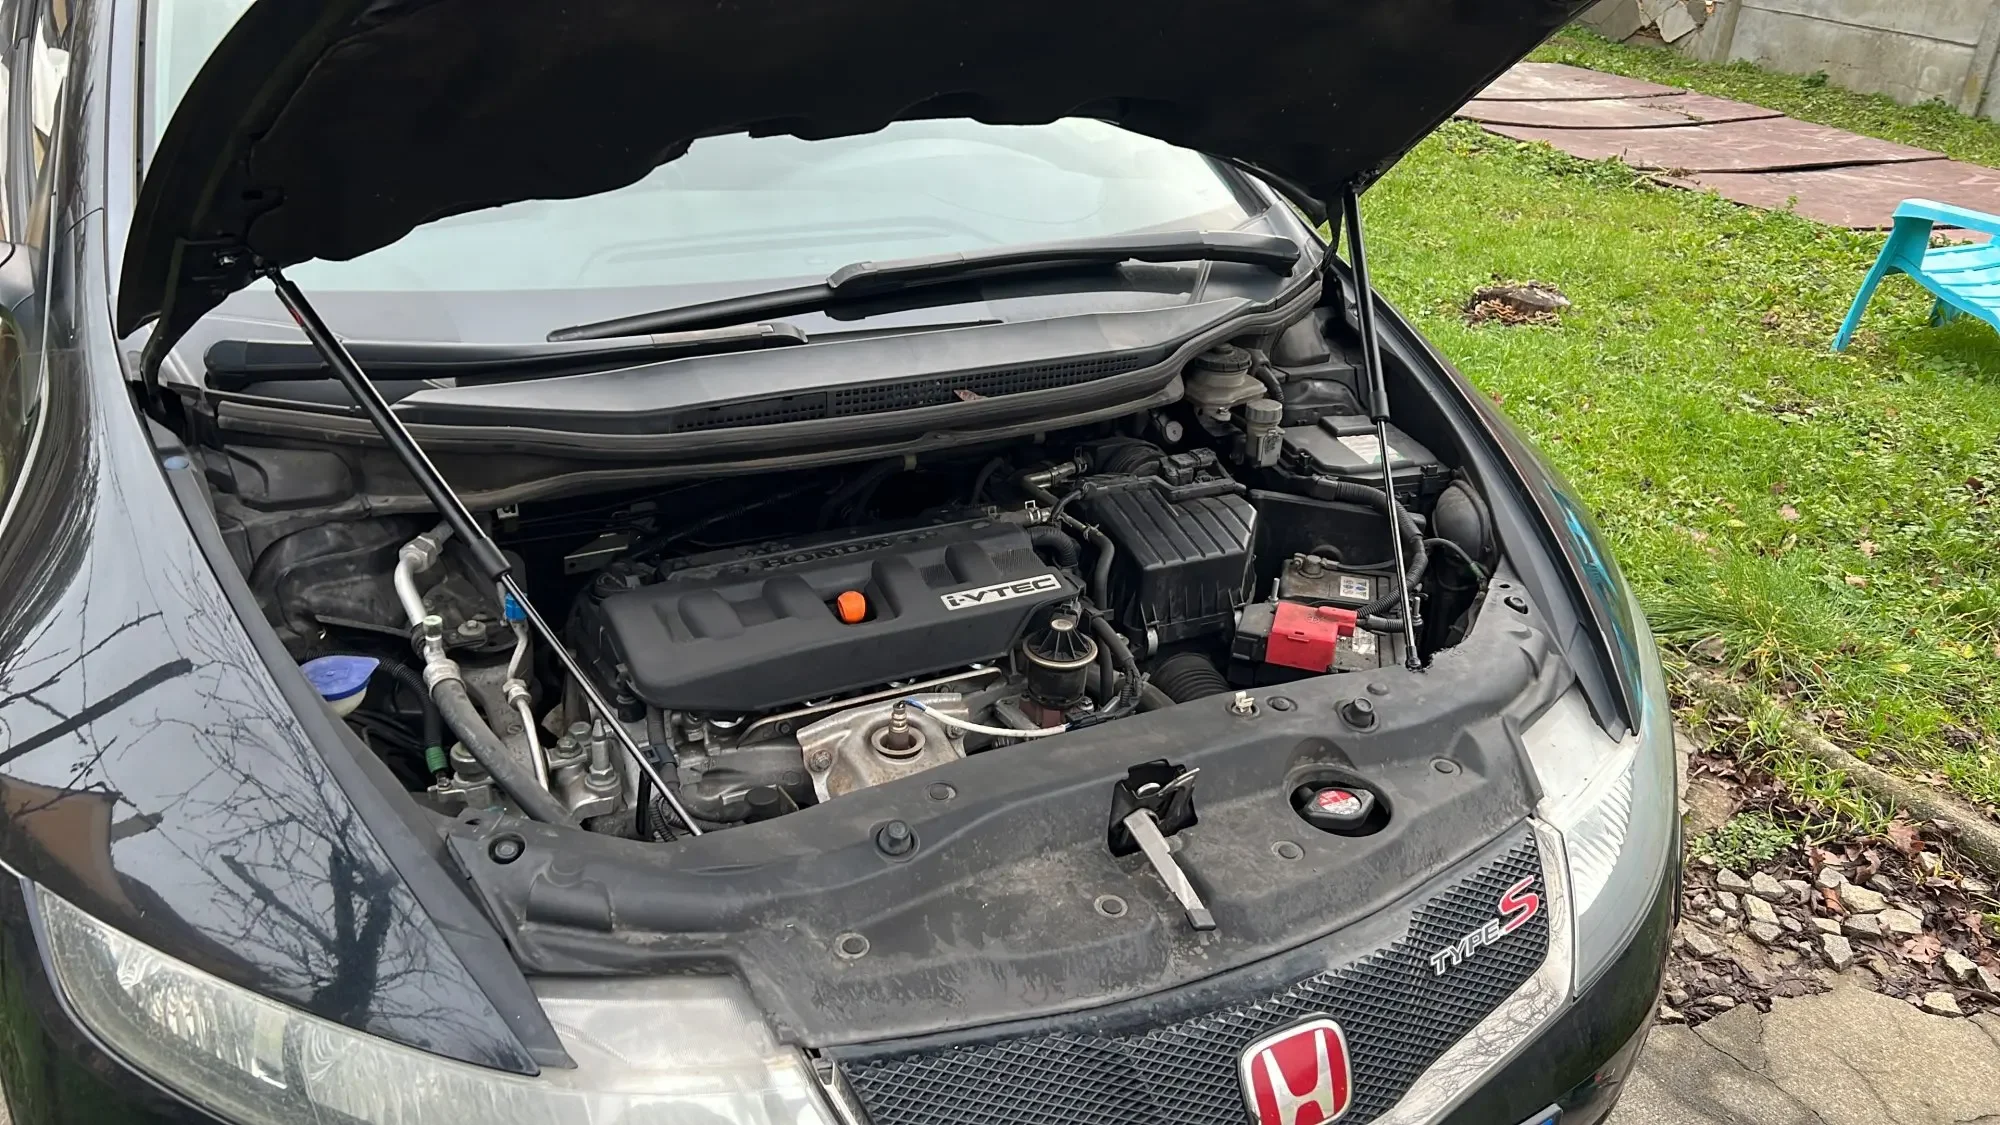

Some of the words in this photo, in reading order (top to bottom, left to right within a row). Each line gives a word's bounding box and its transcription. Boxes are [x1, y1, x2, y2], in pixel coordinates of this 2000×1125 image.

[762, 538, 893, 571] HONDA
[946, 577, 1056, 607] i-VTEC
[1430, 917, 1501, 976] TYPE
[1498, 874, 1540, 935] S
